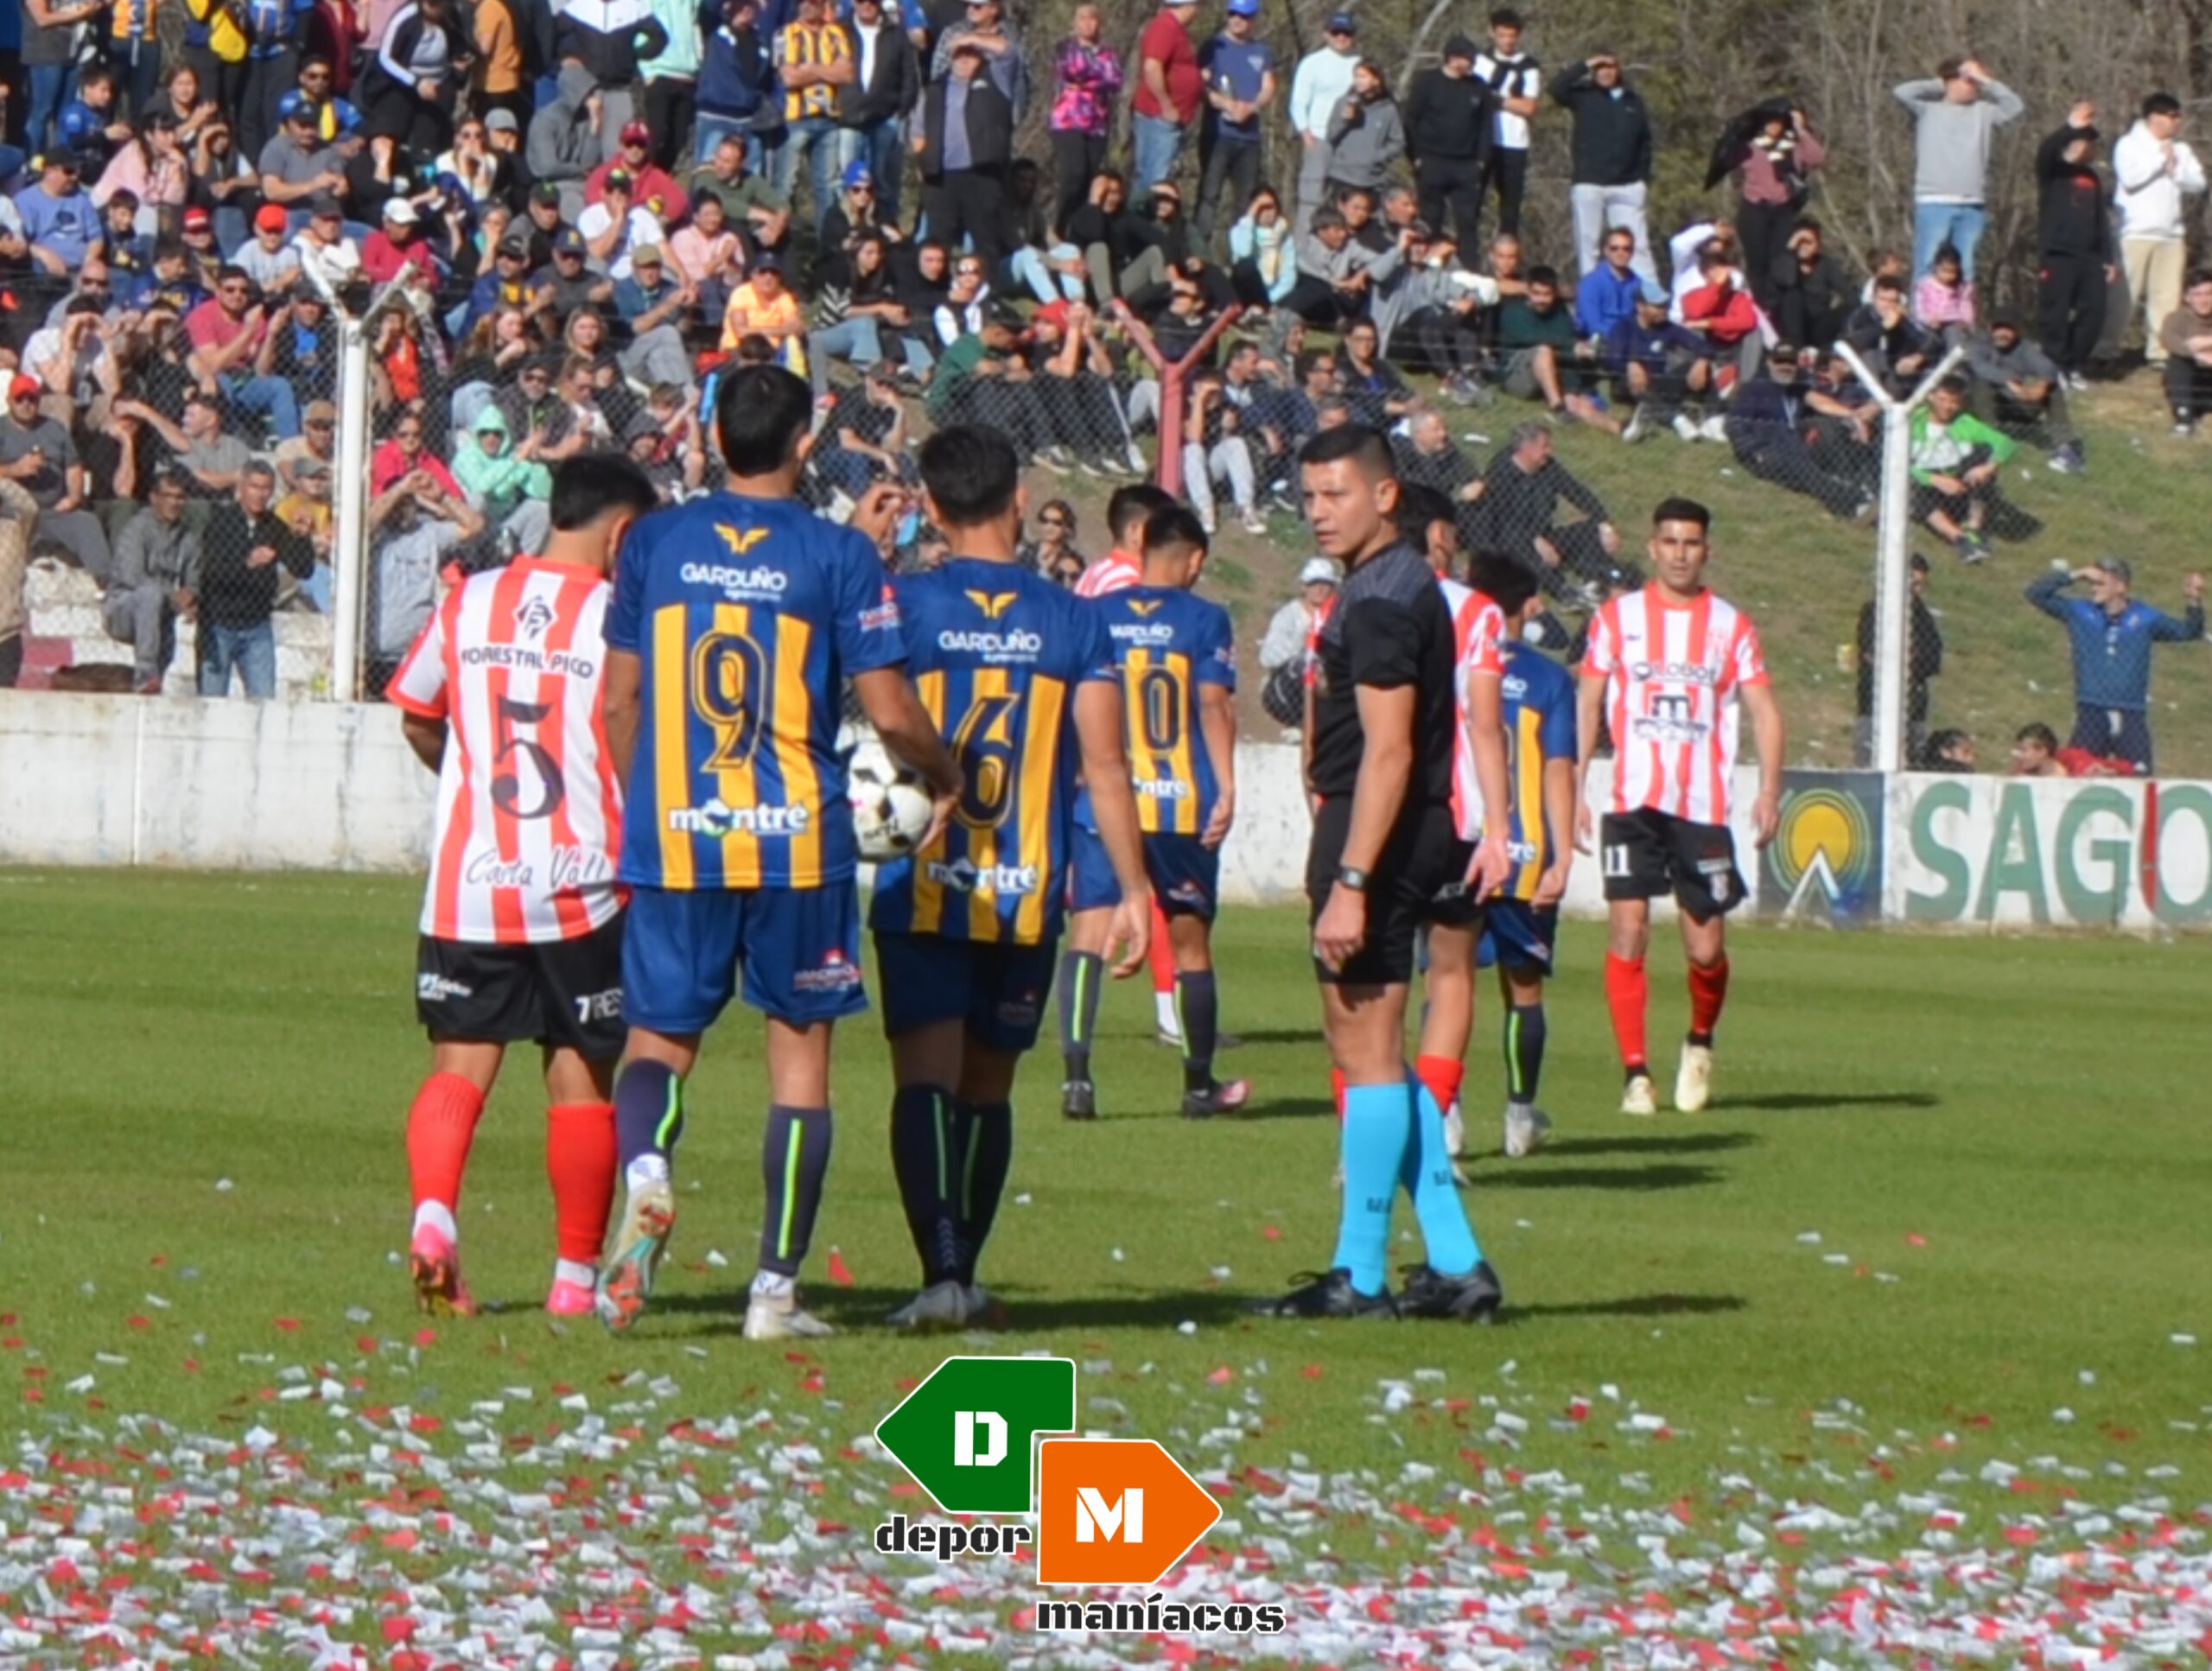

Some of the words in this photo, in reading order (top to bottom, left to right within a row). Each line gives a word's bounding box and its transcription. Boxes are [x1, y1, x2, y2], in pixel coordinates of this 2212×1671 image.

[550, 653, 594, 679] PICO
[690, 628, 767, 772] 9
[489, 695, 564, 819] 5
[952, 692, 1020, 829] 6
